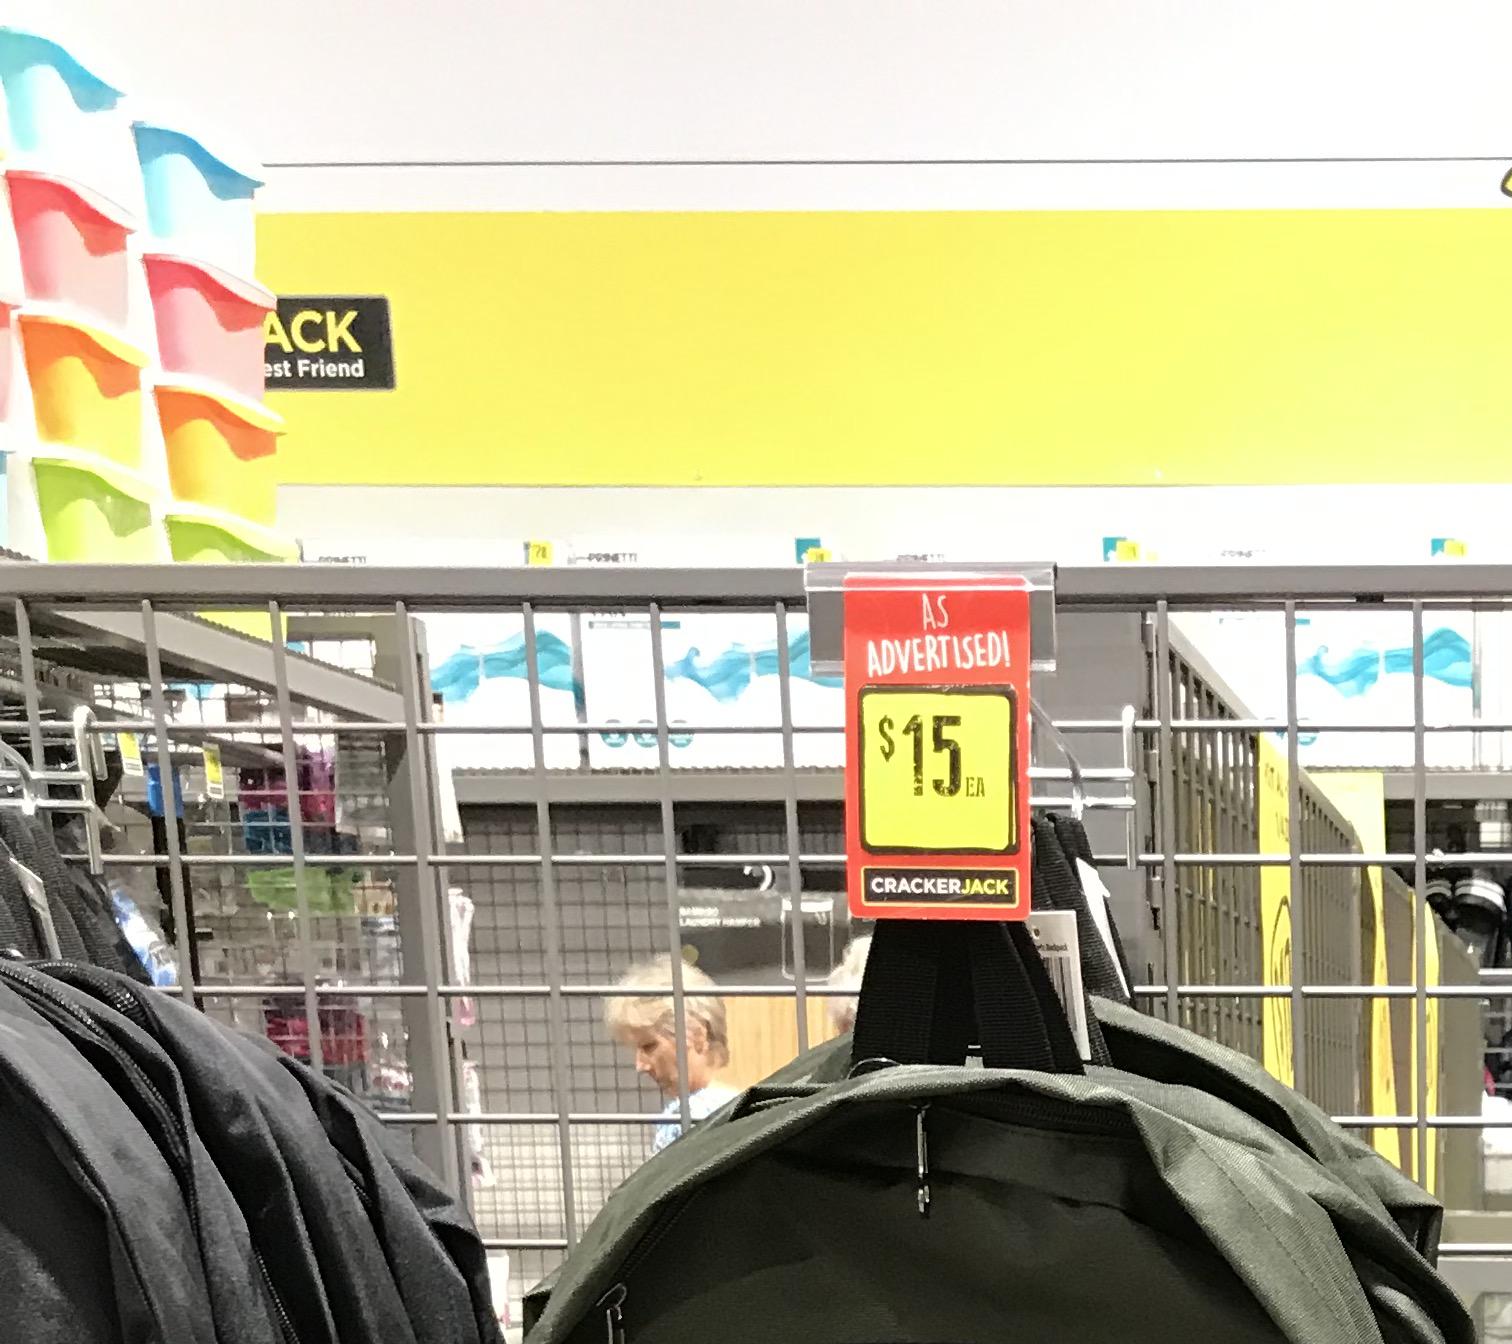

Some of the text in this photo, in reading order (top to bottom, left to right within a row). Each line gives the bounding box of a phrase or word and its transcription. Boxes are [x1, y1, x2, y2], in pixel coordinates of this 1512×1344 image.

[263, 310, 363, 353] ACK
[298, 358, 365, 378] Friend
[922, 593, 949, 630] AS
[867, 630, 1011, 678] ADVERTISED!
[966, 777, 986, 797] EA
[871, 877, 1009, 895] CRACKERJACK
